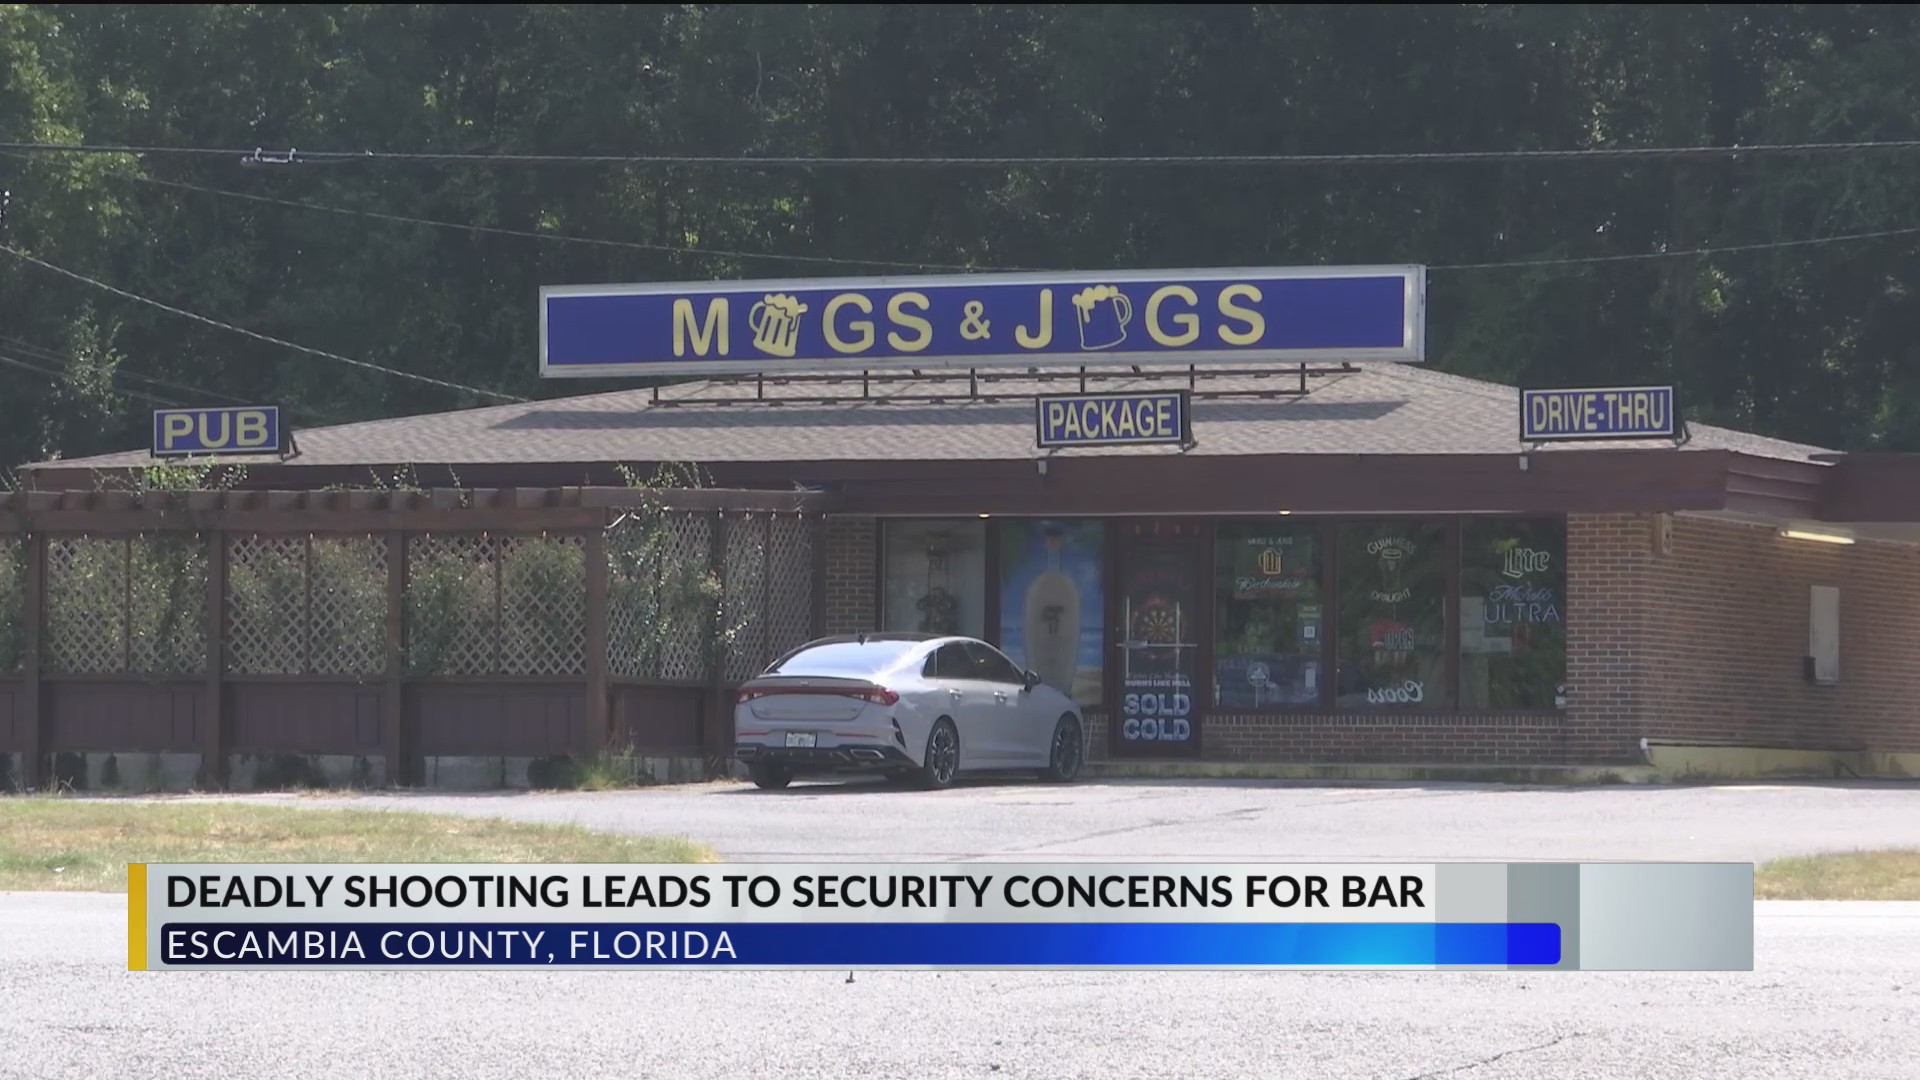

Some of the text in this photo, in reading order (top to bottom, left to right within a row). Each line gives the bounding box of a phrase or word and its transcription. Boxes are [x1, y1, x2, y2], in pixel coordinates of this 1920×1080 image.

[672, 283, 1266, 356] MGS & JGS
[1048, 398, 1173, 440] PACKAGE
[1532, 388, 1665, 432] DRIVE-THRU
[164, 410, 269, 449] PUB
[1502, 548, 1551, 578] Lite
[1484, 602, 1560, 624] ULTRA
[1123, 693, 1191, 717] SOLD
[1123, 718, 1191, 742] COLD
